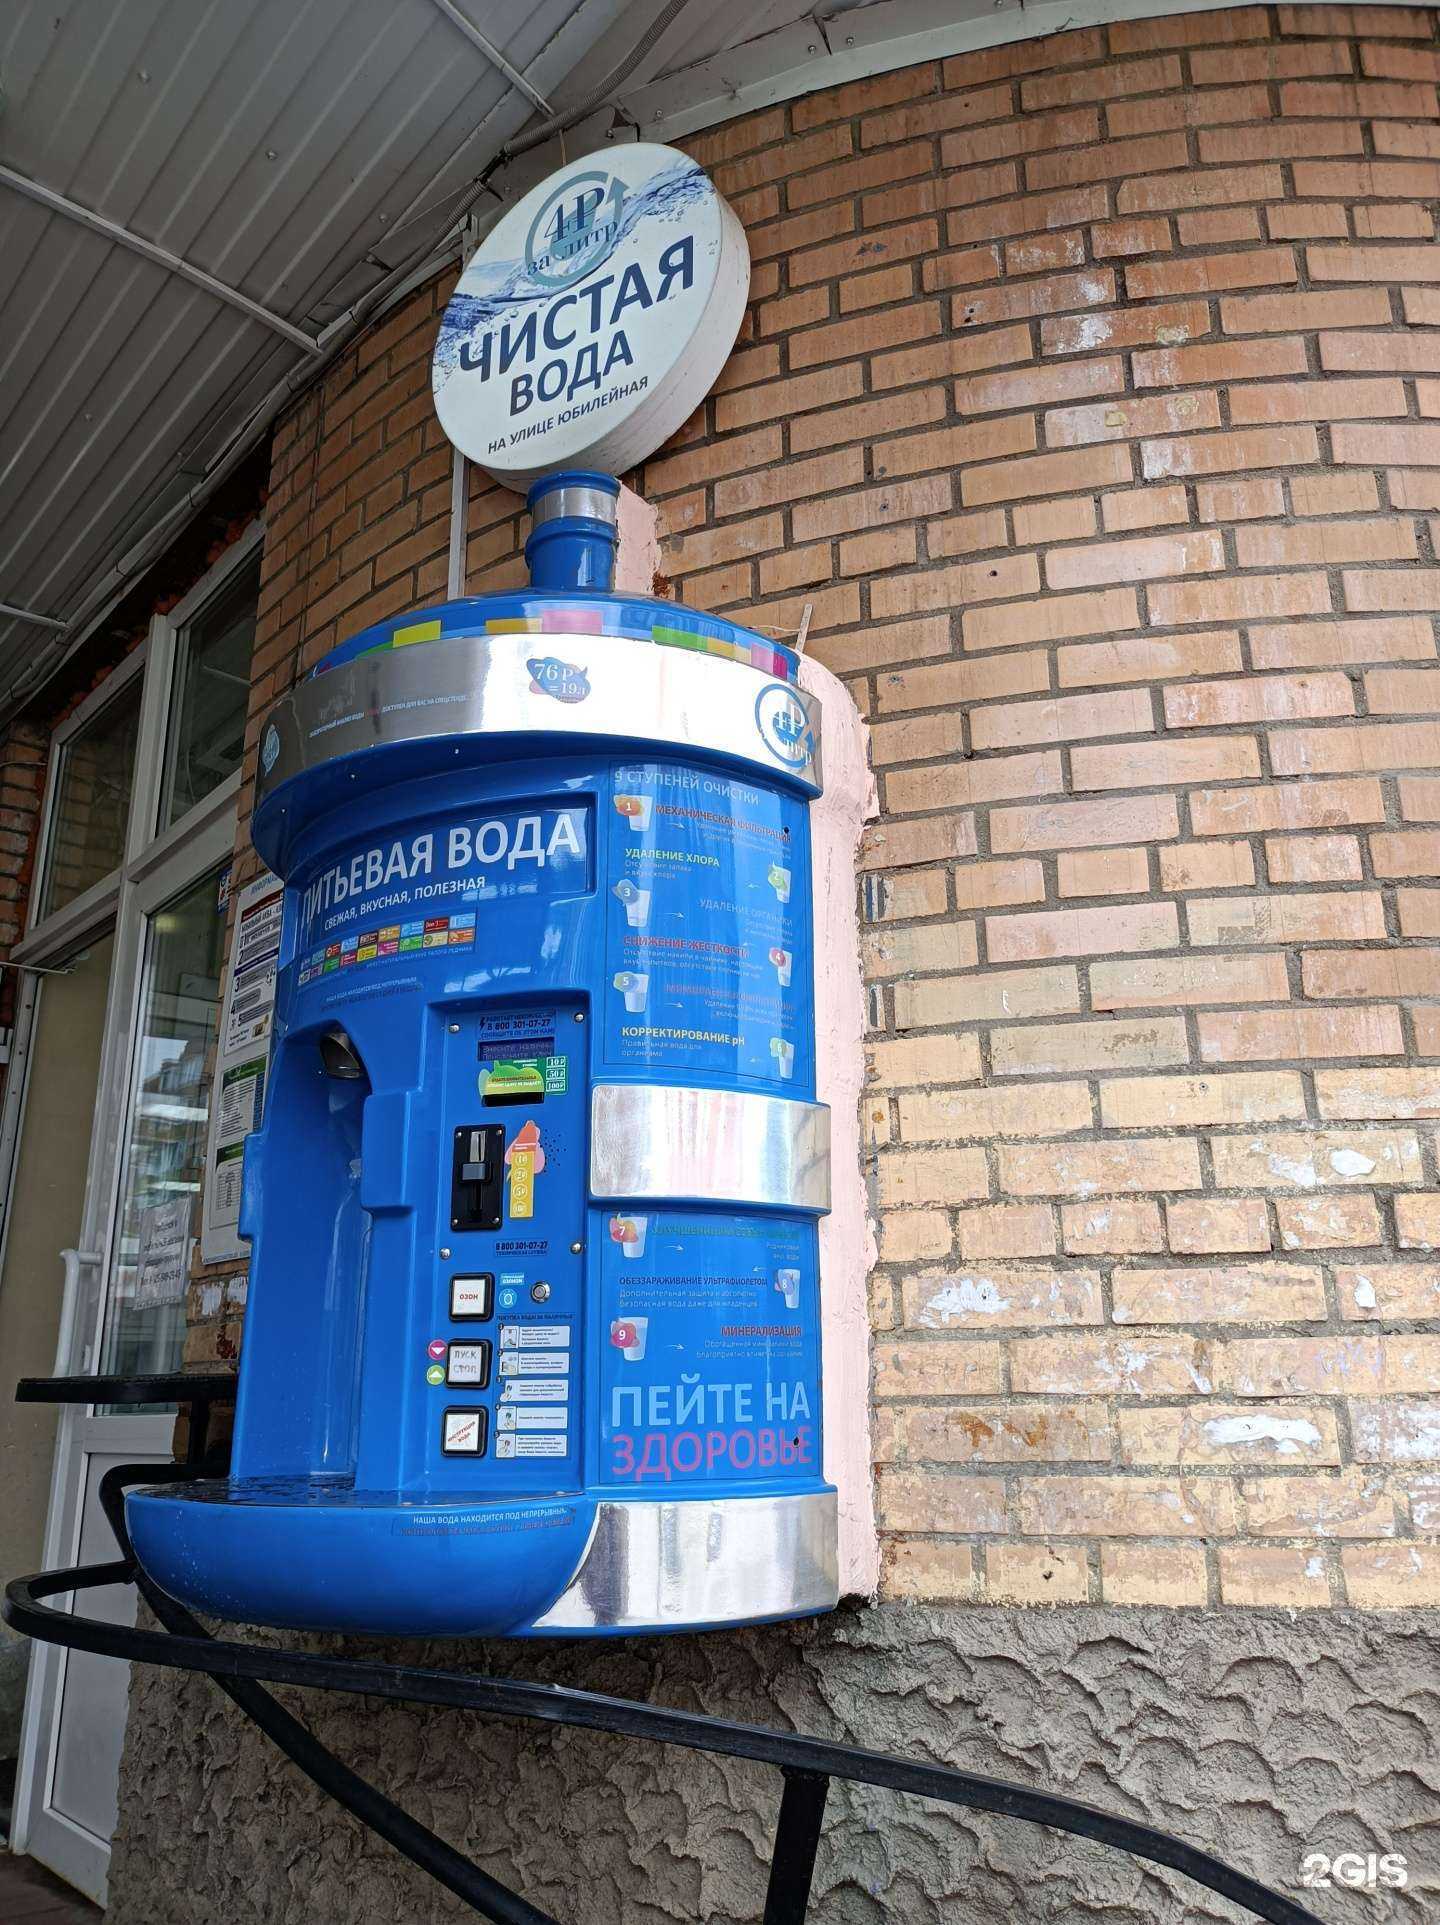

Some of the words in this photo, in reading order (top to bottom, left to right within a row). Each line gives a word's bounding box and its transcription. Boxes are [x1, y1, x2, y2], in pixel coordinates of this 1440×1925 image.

[460, 235, 694, 383] ЧИСТАЯ
[510, 330, 634, 416] ВОДА
[488, 437, 507, 454] НА
[510, 417, 554, 447] УЛИЦЕ
[557, 376, 649, 426] ЮБИЛЕЙНАЯ
[534, 664, 558, 681] 76
[627, 770, 699, 791] СТУПЕНЕЙ
[704, 781, 760, 806] ОЧИСТКИ
[626, 802, 632, 811] 1
[625, 848, 684, 862] УДАЛЕНИЕ
[686, 853, 720, 868] ХЛОРА
[301, 833, 433, 929] ПИТЬЕВАЯ
[448, 813, 580, 871] ВОДА
[623, 888, 632, 897] 3
[324, 905, 358, 931] СВЕЖАЯ,
[360, 891, 412, 918] ВКУСНАЯ,
[414, 877, 486, 900] ПОЛЕЗНАЯ
[234, 976, 241, 993] 3
[623, 976, 630, 986] 5
[495, 1021, 509, 1030] 800
[513, 1018, 551, 1029] 301-07-27
[622, 1027, 731, 1044] КОРРЕКТИРОВАНИЕ
[618, 1226, 625, 1236] 7
[501, 1242, 514, 1250] 800
[515, 1241, 548, 1250] 301-07-27
[619, 1330, 626, 1341] 9
[721, 1325, 802, 1338] МИНЕРАЛИЗАЦИЯ
[454, 1350, 477, 1360] ПУСК
[612, 1373, 753, 1428] ПЕЙТЕ
[766, 1381, 811, 1422] НА
[612, 1425, 812, 1482] ЗДОРОВЬЕ
[413, 1516, 437, 1524] НАША
[437, 1515, 459, 1525] ВОДА
[460, 1514, 504, 1524] НАХОДИТСЯ
[505, 1513, 520, 1521] ПОД
